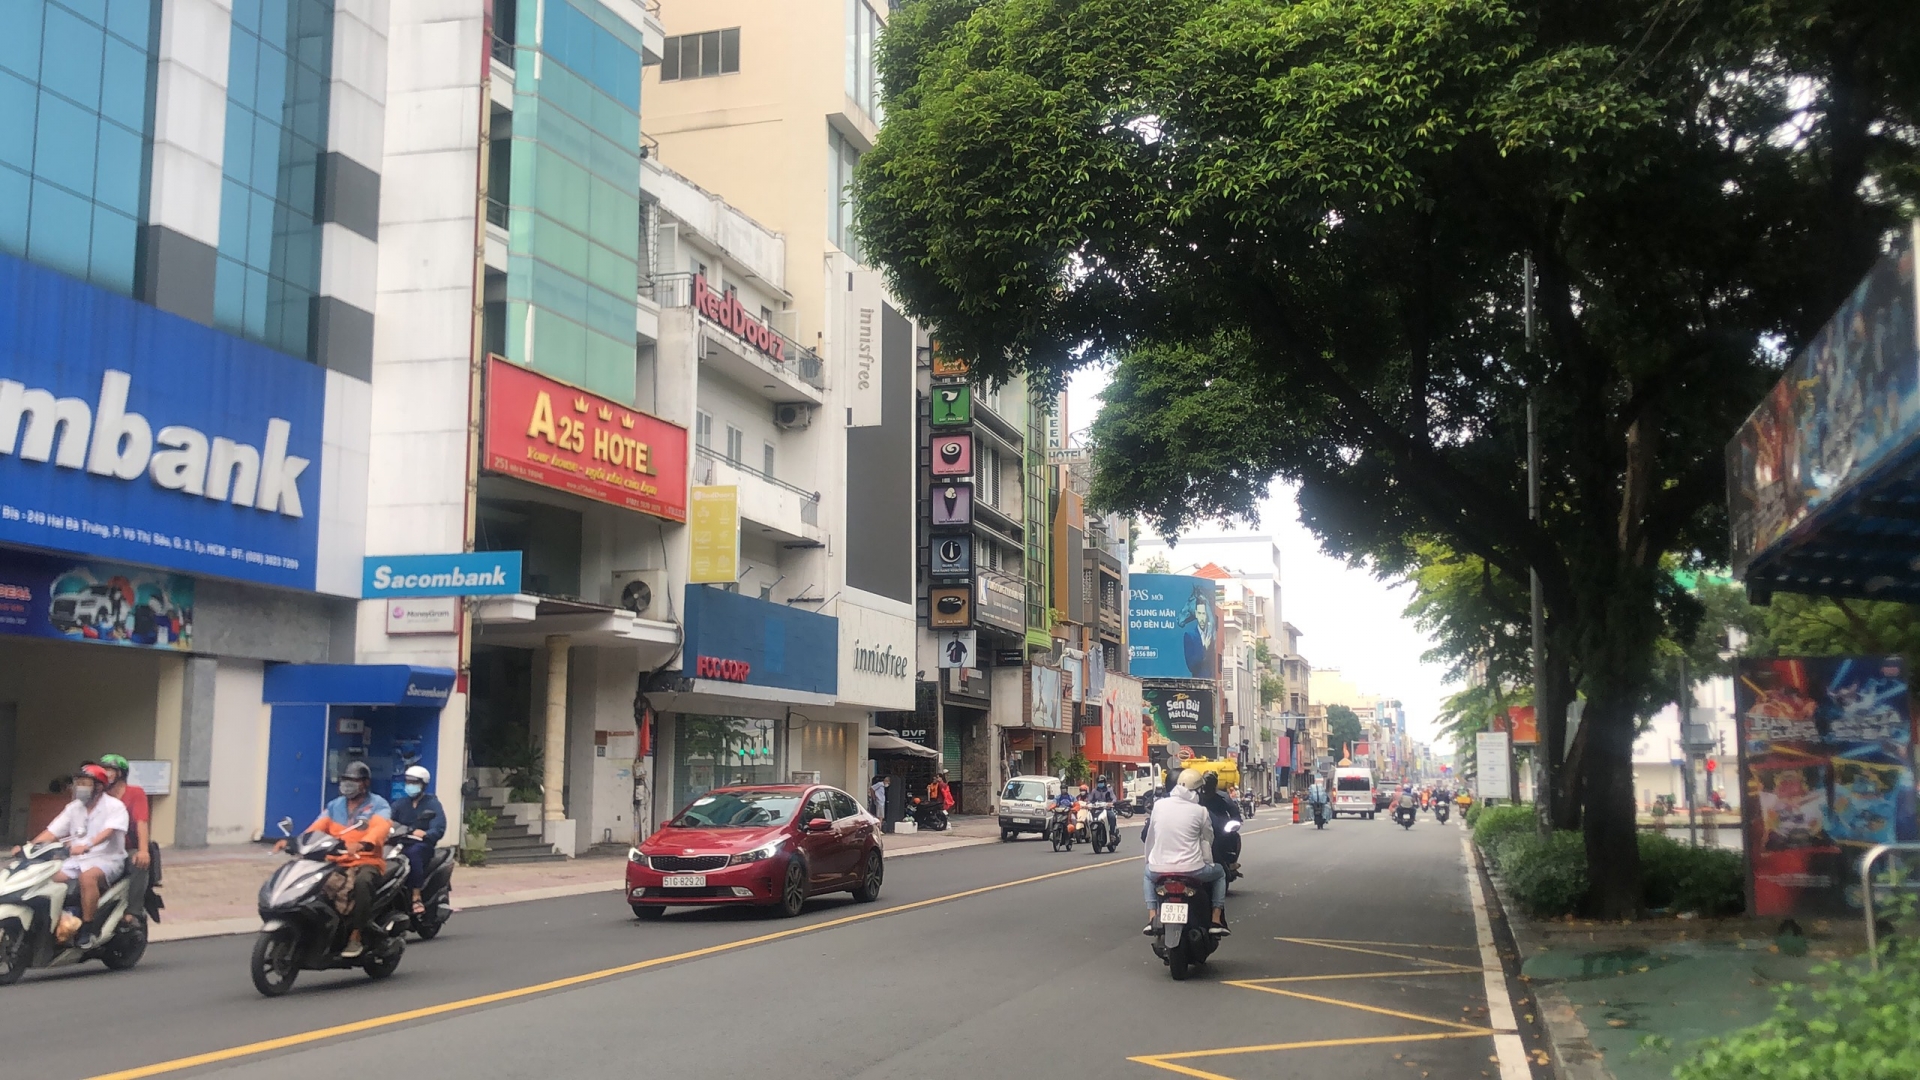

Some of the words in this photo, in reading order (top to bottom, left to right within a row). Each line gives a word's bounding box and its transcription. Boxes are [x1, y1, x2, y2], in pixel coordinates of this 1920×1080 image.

[692, 273, 786, 363] RedDoorz
[857, 307, 875, 391] innisfree
[494, 456, 509, 470] 251
[527, 446, 550, 464] Your
[550, 453, 579, 472] house
[593, 427, 657, 477] HOTEL
[47, 514, 64, 529] Hai
[66, 517, 79, 532] Bà
[373, 564, 507, 590] Sacombank
[1159, 608, 1176, 617] MÃN
[1130, 620, 1141, 630] ĐỘ
[1161, 620, 1175, 628] LÂU
[854, 639, 908, 678] innisfree
[407, 684, 448, 698] Sacombank
[1166, 700, 1184, 711] Sen
[1186, 700, 1200, 712] Bùi
